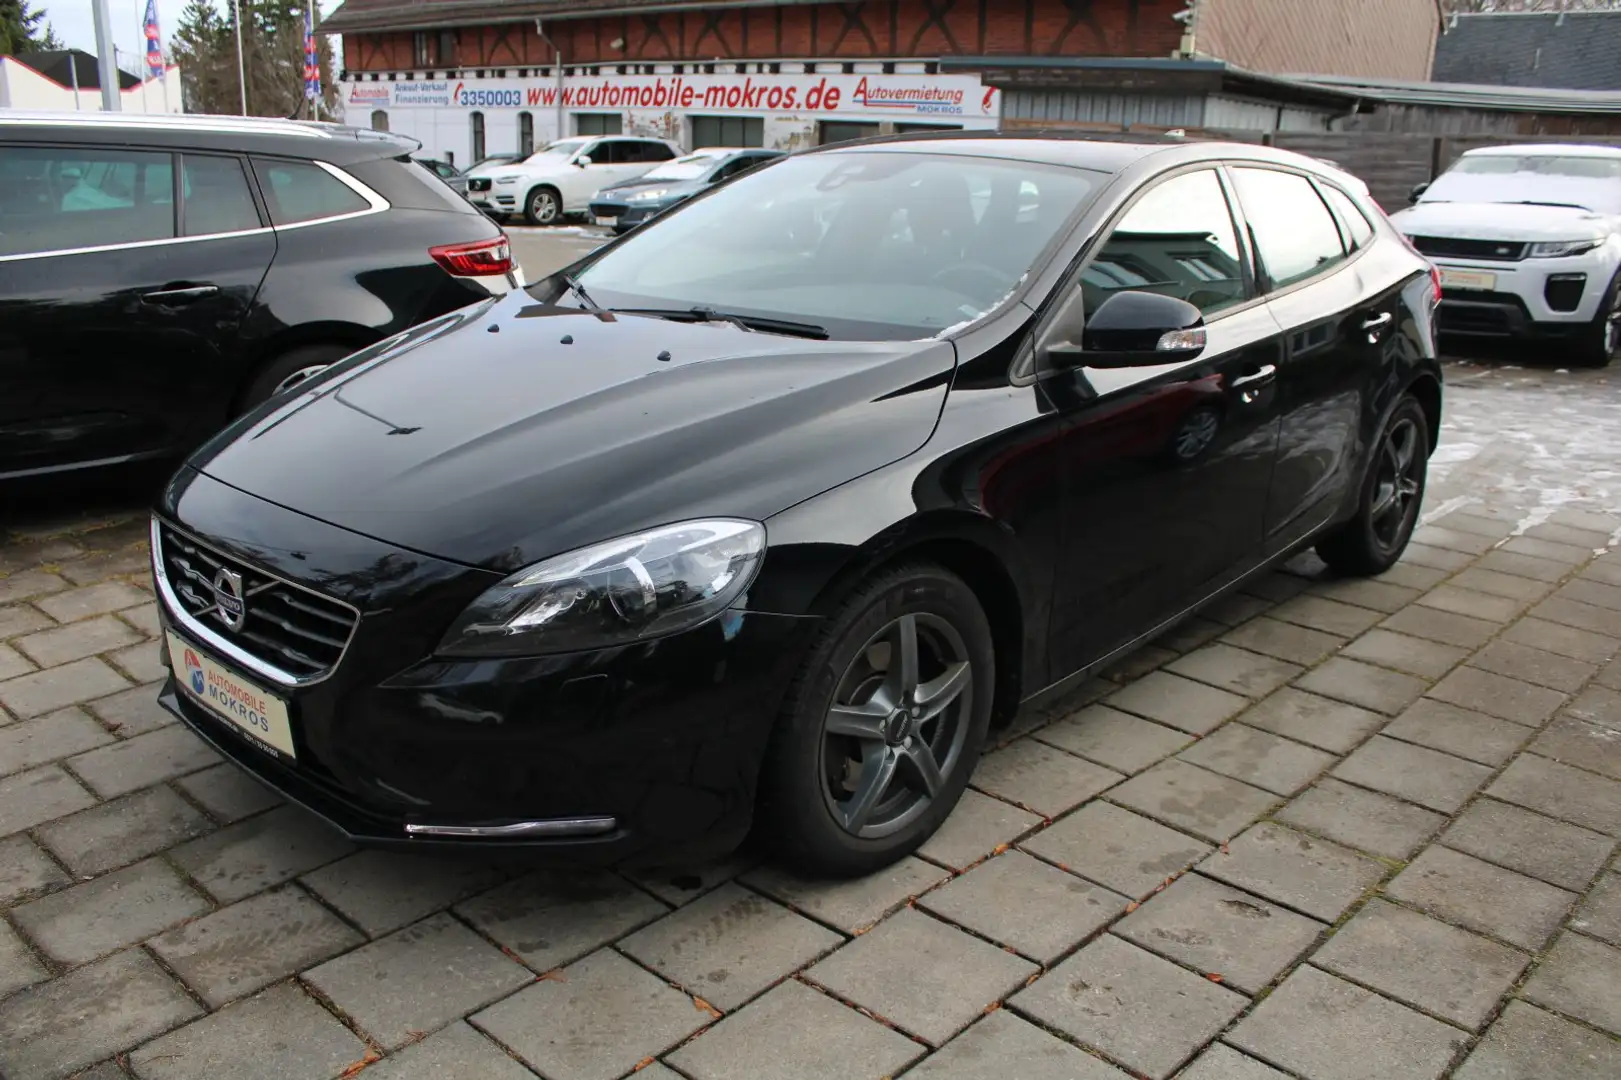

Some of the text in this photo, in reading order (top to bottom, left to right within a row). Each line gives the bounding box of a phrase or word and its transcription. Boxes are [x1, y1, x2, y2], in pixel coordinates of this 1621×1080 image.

[395, 83, 447, 92] Ankauf-Verkauf
[461, 90, 521, 106] 3350003
[527, 77, 841, 110] www.automobile-mokros.de
[853, 76, 963, 104] Autovermietung
[395, 94, 448, 105] Finanzierung
[917, 106, 963, 114] MOKROS
[208, 670, 267, 715] AUTOMOBILE
[209, 685, 269, 733] MOKROS
